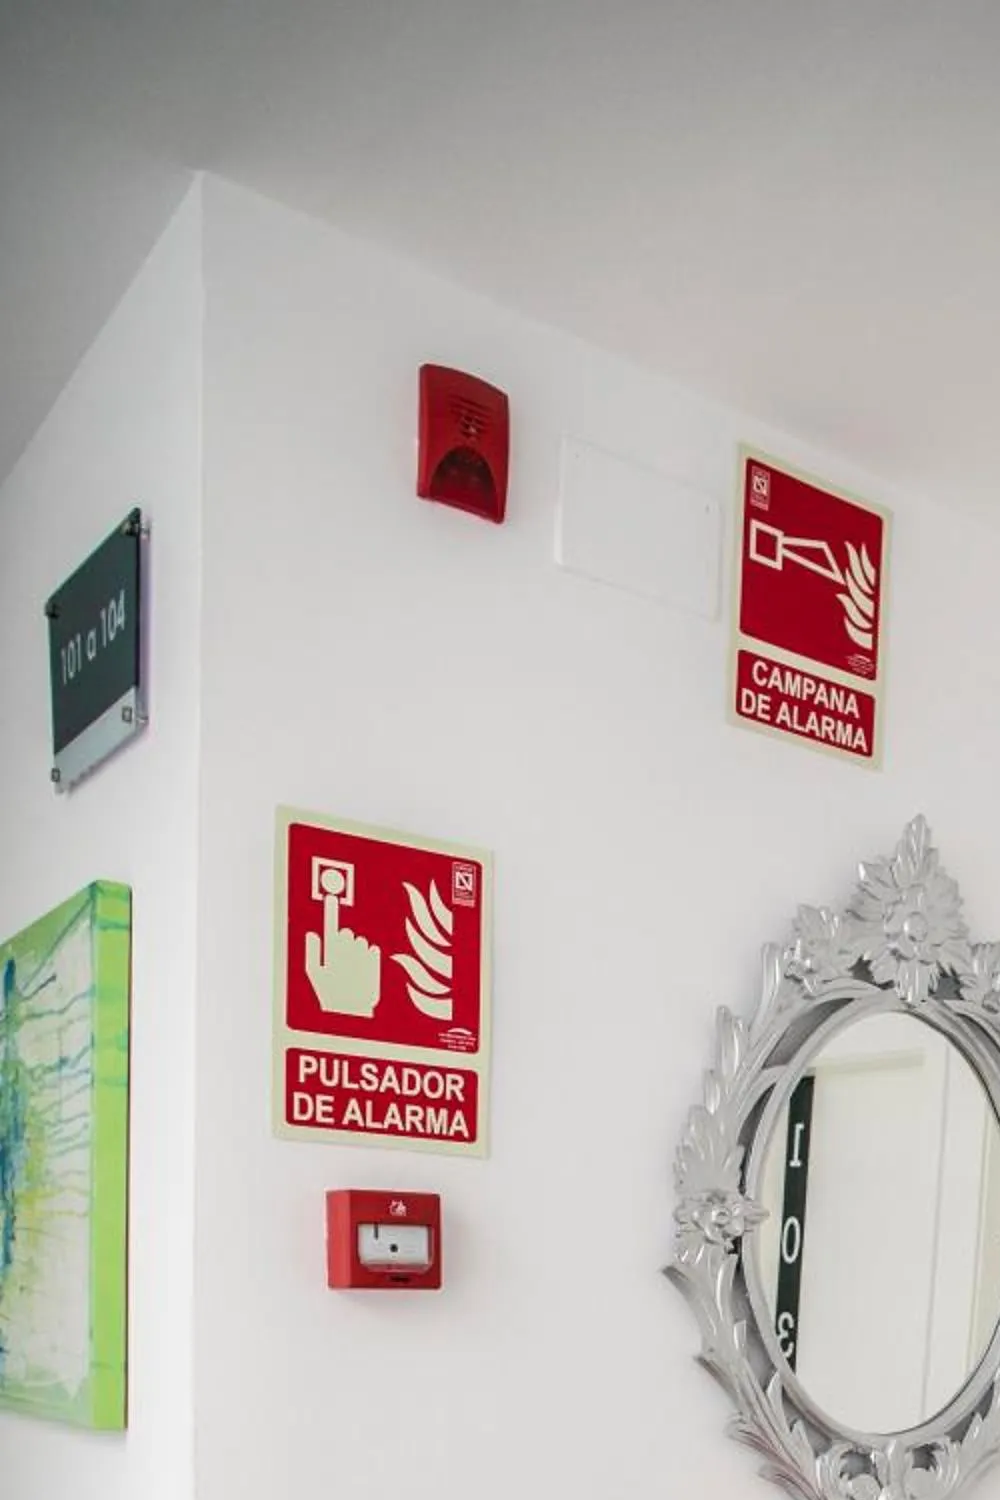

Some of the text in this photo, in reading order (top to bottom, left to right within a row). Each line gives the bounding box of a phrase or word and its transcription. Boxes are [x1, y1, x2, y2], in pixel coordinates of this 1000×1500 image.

[61, 589, 125, 686] 101 a 104
[751, 660, 860, 719] CAMPANA
[740, 688, 869, 752] DE ALARMA
[299, 1054, 465, 1103] PULSADOR
[292, 1091, 470, 1138] DE ALARMA
